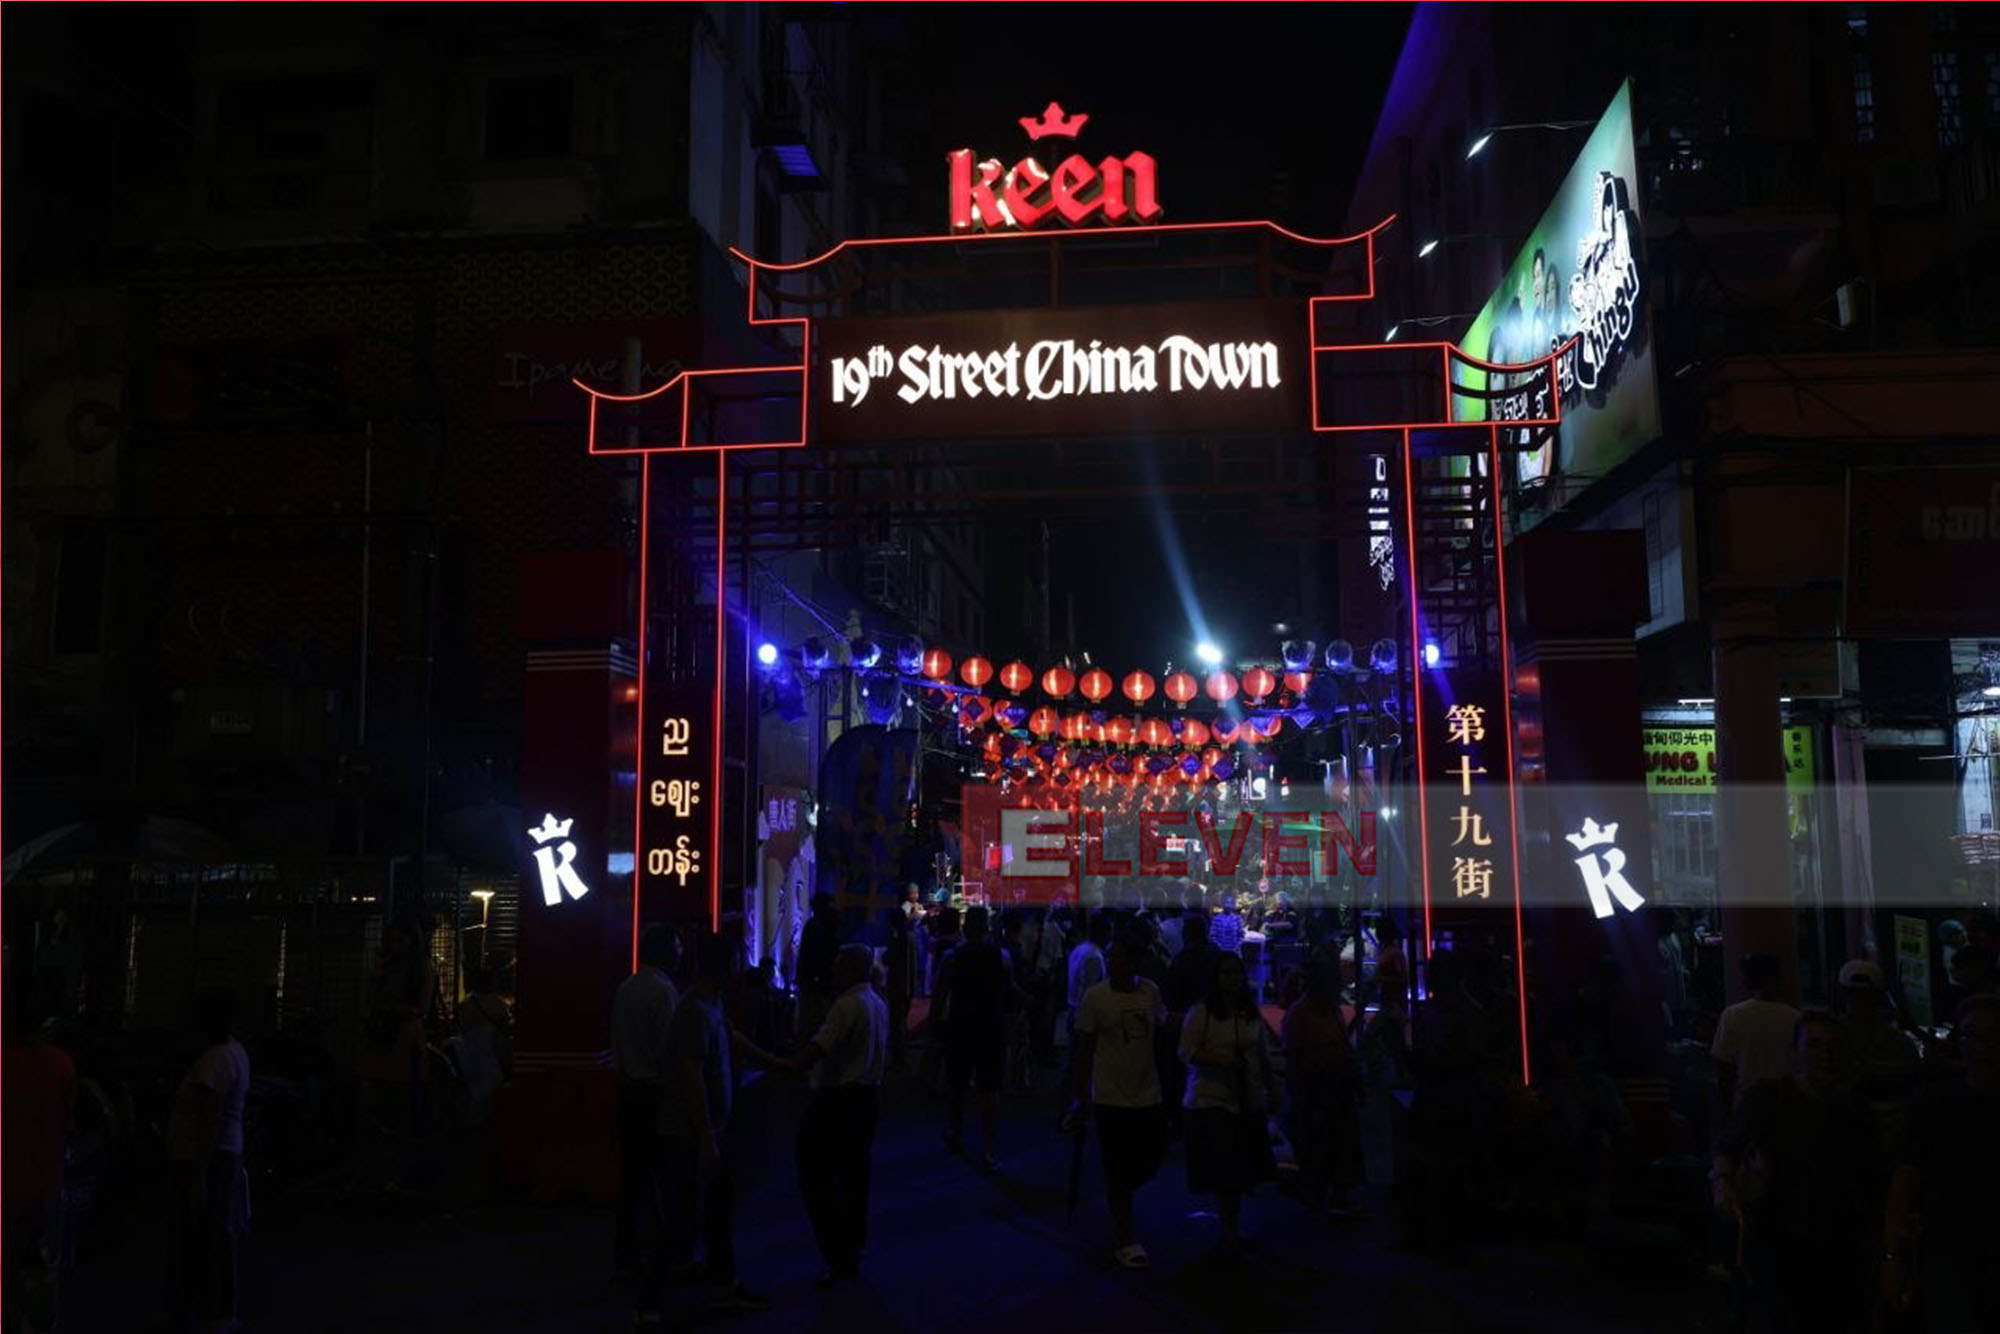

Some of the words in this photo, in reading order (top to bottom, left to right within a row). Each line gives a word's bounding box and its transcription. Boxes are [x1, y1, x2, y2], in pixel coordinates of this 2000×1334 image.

[948, 148, 1162, 230] keen
[897, 341, 1021, 405] Street
[1023, 339, 1158, 401] China
[1158, 334, 1282, 392] Town
[1444, 704, 1494, 899] 第十九街
[1655, 774, 1707, 787] Medical
